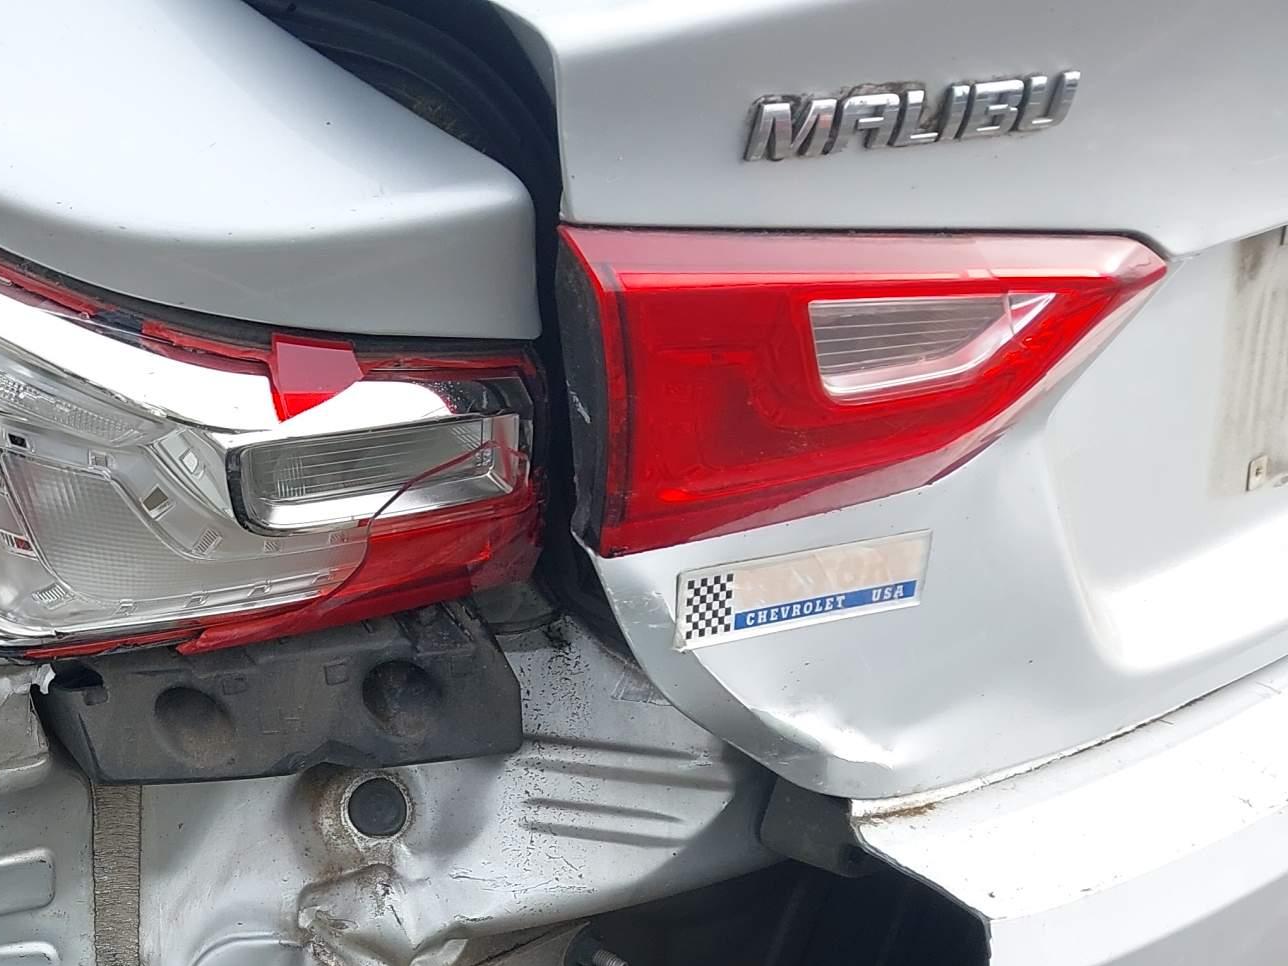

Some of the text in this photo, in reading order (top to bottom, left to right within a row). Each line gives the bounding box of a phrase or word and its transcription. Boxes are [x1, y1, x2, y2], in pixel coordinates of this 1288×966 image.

[743, 70, 1081, 162] MALIBU
[746, 584, 905, 626] CHEVROLET USA
